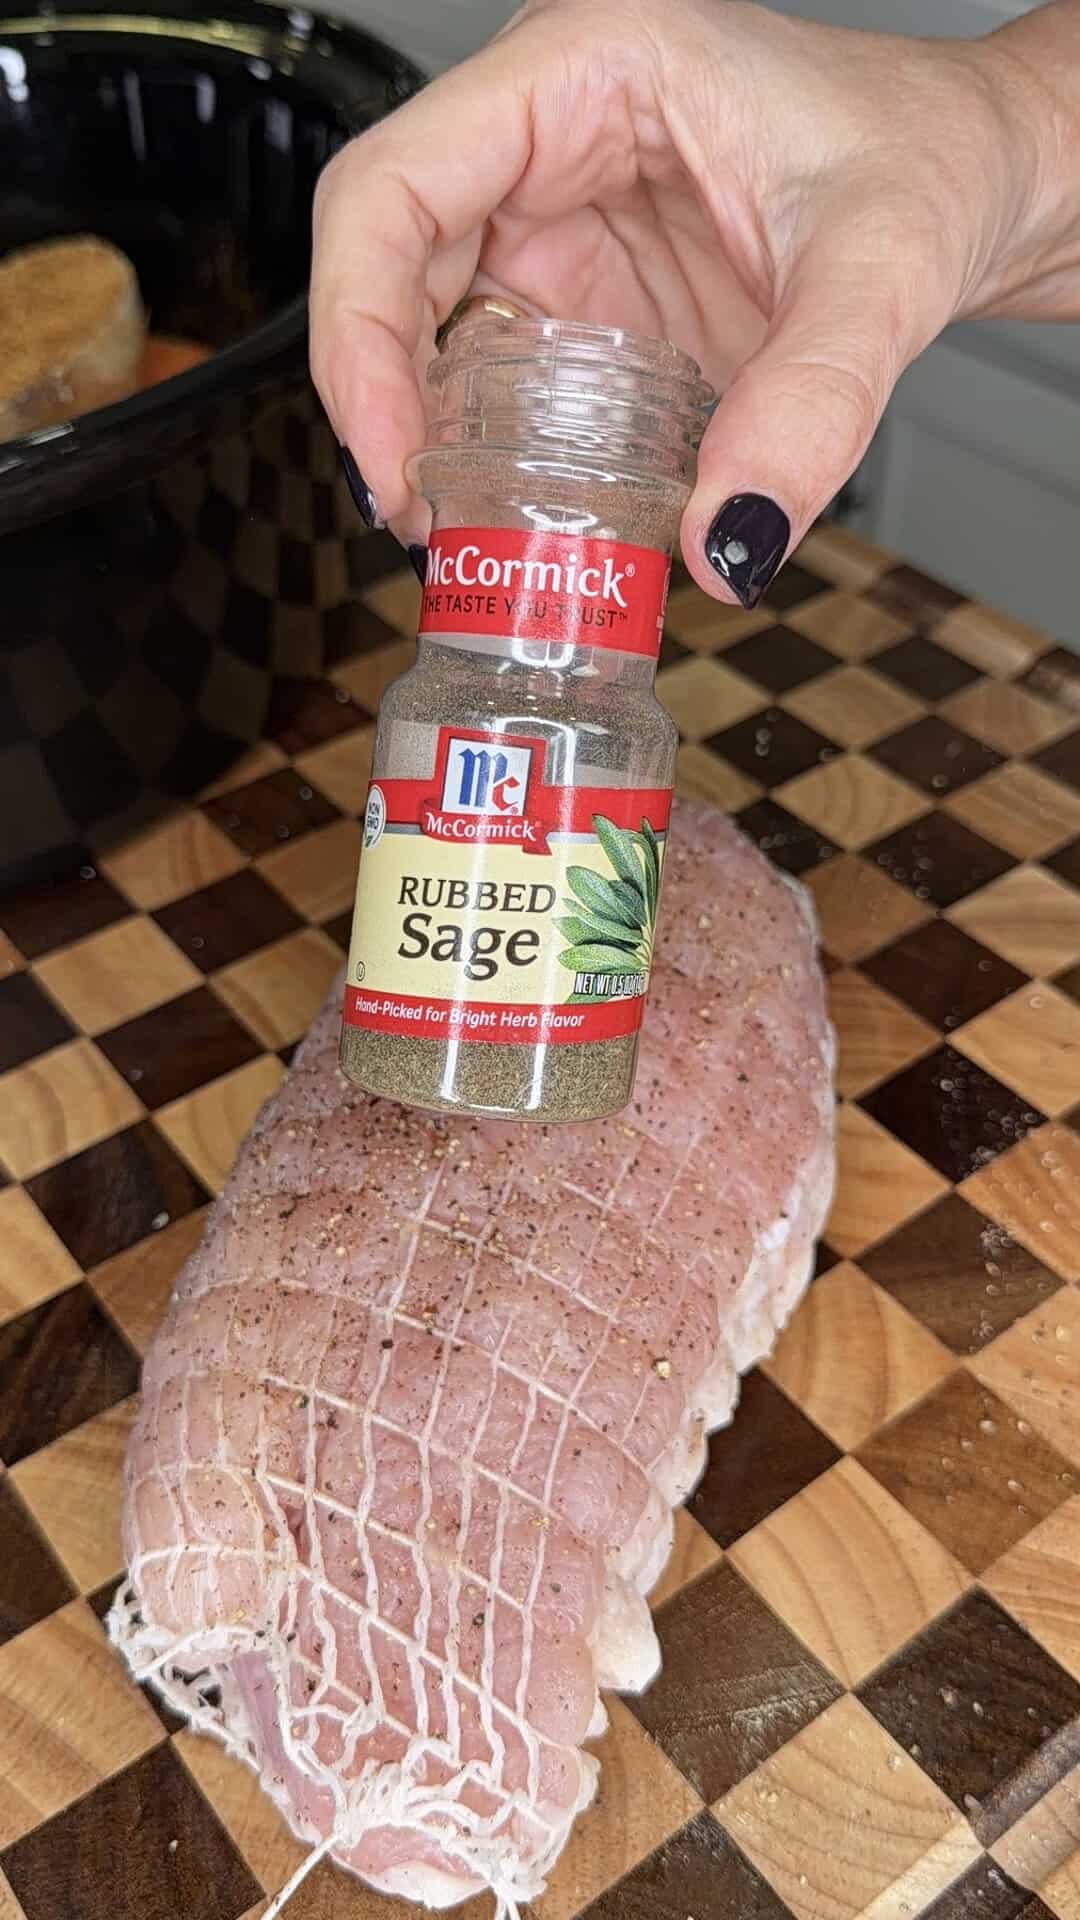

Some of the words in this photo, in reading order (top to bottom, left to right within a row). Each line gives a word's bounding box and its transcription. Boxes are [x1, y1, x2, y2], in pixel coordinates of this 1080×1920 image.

[424, 594, 441, 614] THE
[444, 594, 496, 615] TASTE
[397, 876, 557, 913] RUBBED
[397, 913, 540, 981] Sage
[574, 972, 595, 994] NET
[595, 973, 611, 995] WT
[355, 996, 422, 1020] Hand-Picked
[425, 1006, 447, 1022] for
[449, 1007, 497, 1029] Bright
[500, 1011, 538, 1028] Herb
[540, 1011, 586, 1028] Flavor
